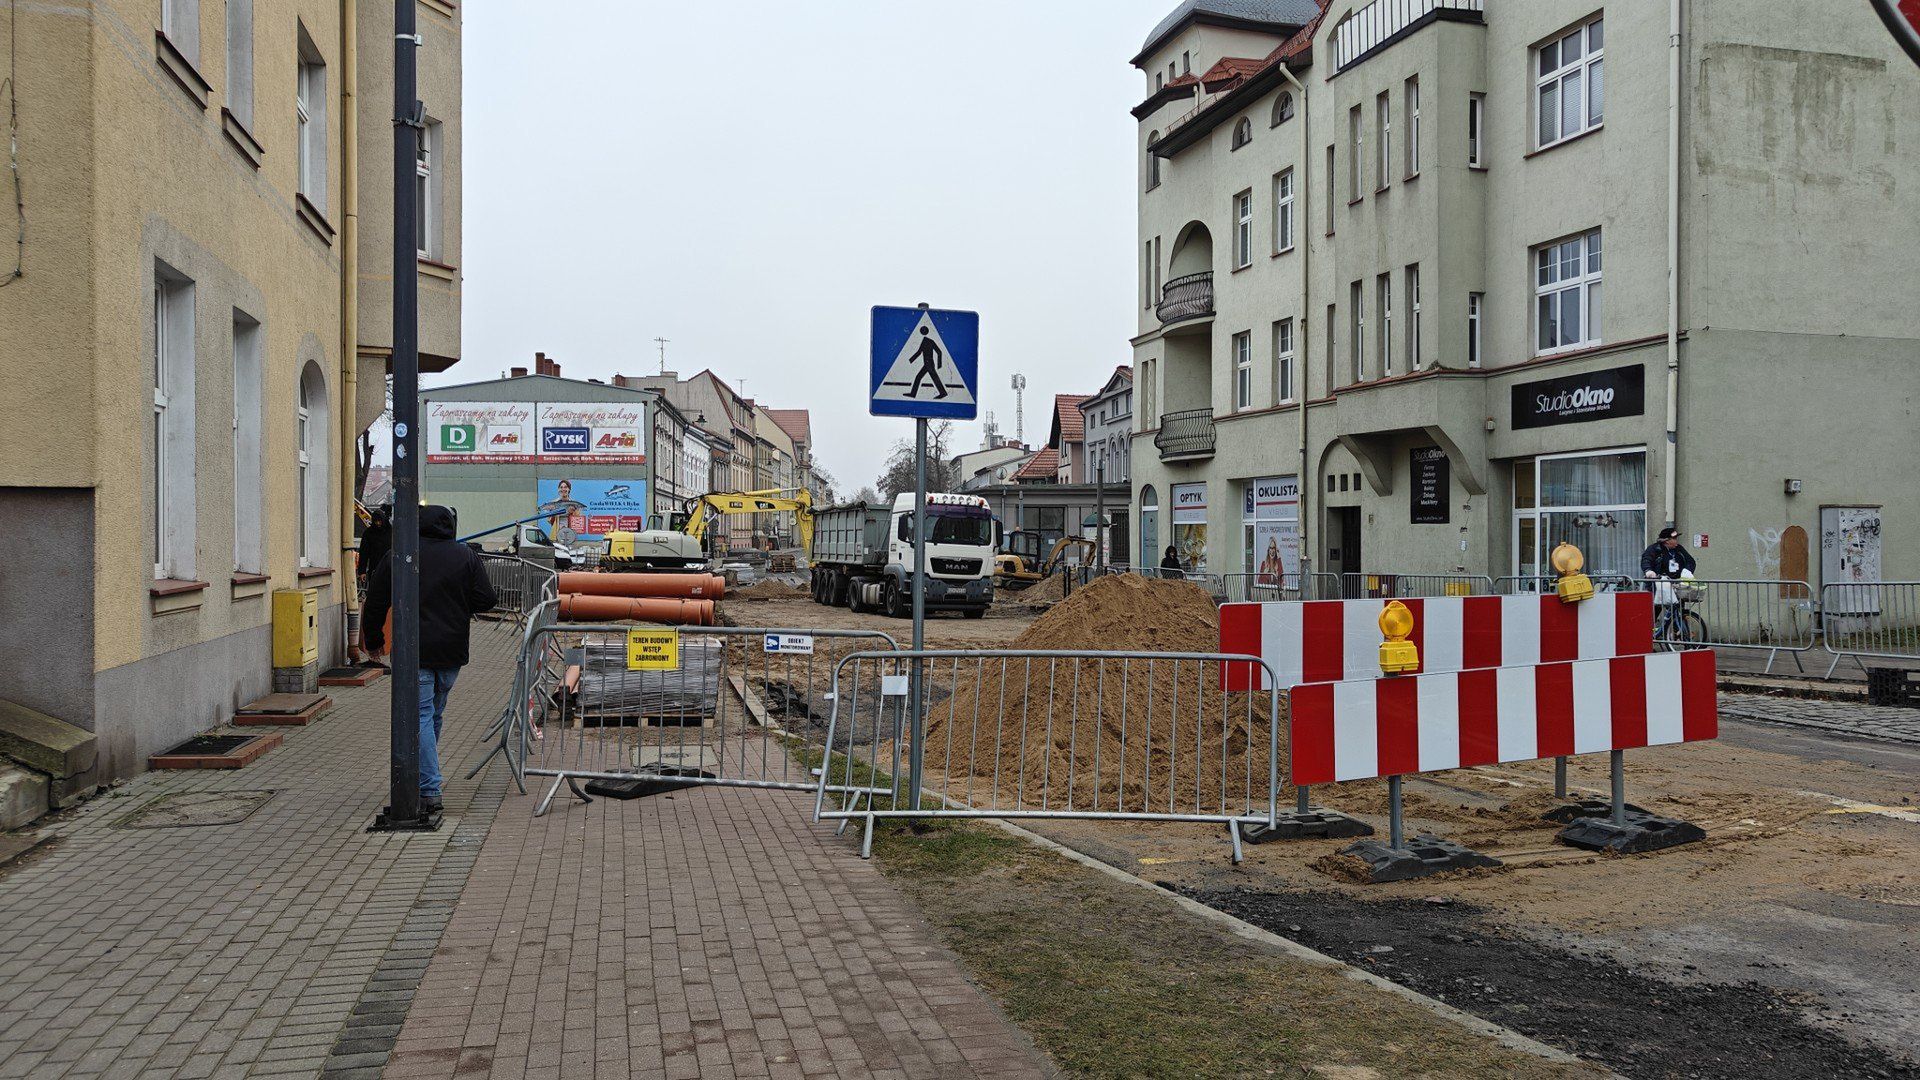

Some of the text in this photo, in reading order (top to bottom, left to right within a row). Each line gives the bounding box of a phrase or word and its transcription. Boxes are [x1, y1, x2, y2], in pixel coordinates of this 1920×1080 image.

[1535, 385, 1615, 413] StudioOkno
[432, 405, 529, 422] Zapraszamy na zakupy
[541, 406, 638, 424] Zapraszamy na zakupy
[449, 427, 467, 445] D
[490, 432, 519, 445] Aria
[554, 433, 585, 445] JYSK
[595, 432, 636, 448] Aria
[1180, 492, 1203, 503] OPTYK
[1258, 484, 1299, 497] OKULISTA
